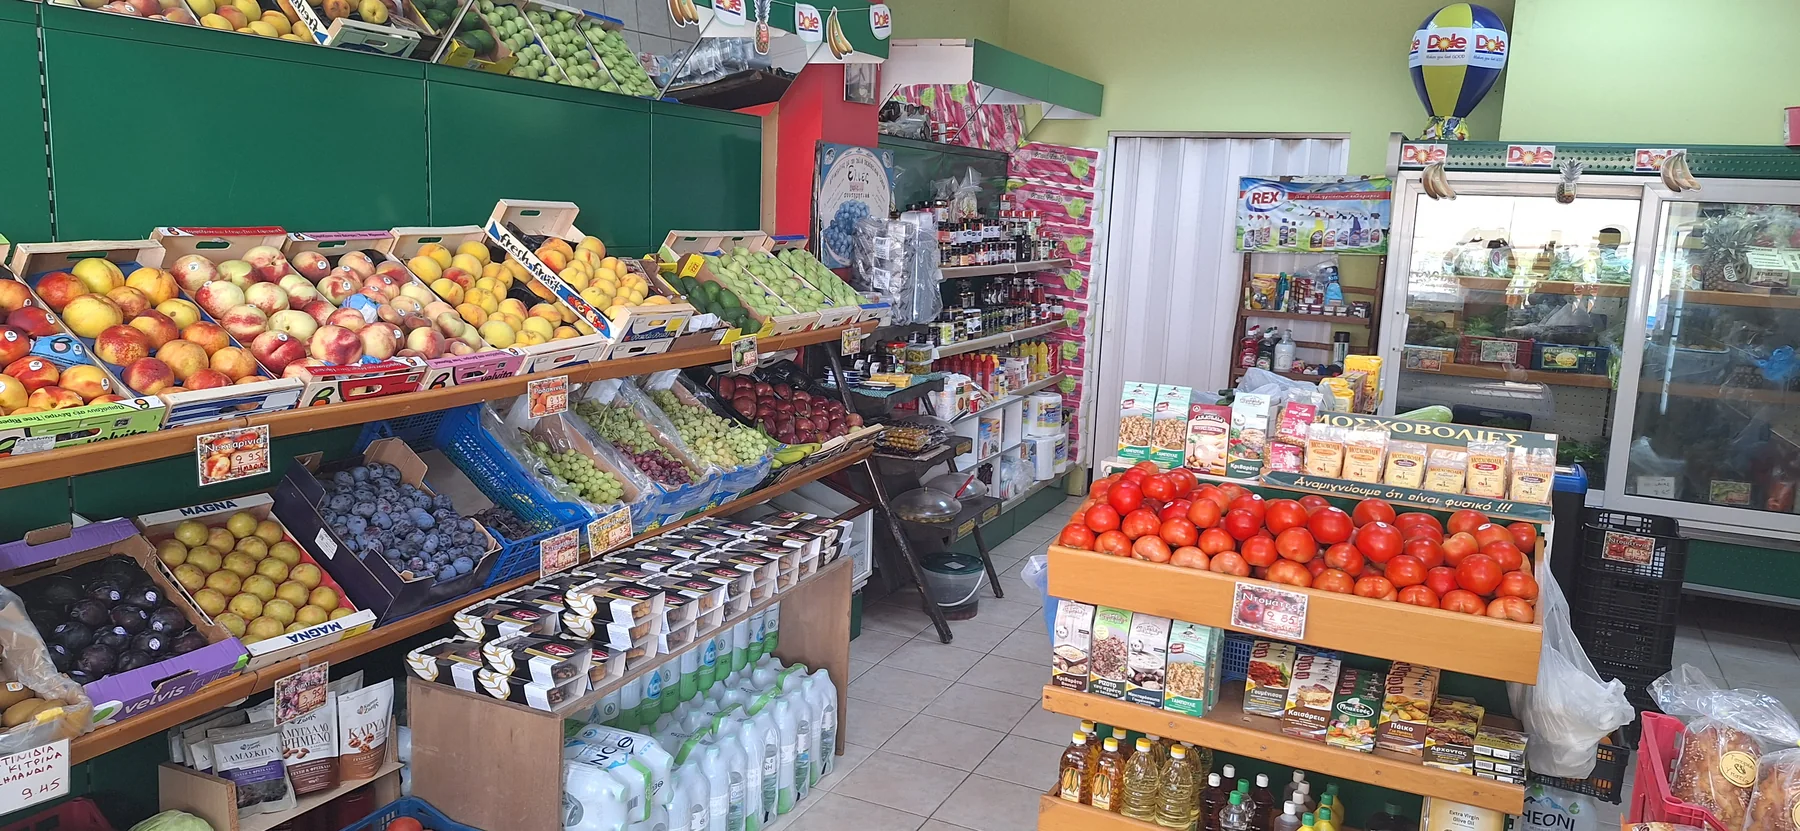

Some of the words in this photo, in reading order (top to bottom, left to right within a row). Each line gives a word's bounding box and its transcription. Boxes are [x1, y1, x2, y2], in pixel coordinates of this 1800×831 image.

[798, 11, 819, 30] Dole
[873, 9, 889, 27] Dole
[1427, 33, 1467, 51] Dole
[1476, 34, 1505, 52] Dole
[1403, 145, 1445, 163] Dole
[1508, 146, 1553, 164] Dole
[1251, 191, 1280, 204] REX
[500, 234, 529, 265] fresh
[533, 263, 561, 292] fruit
[1294, 476, 1381, 498] Αναμιγνύουμε
[1387, 488, 1406, 501] ότι
[1408, 493, 1440, 504] είναι
[1445, 498, 1491, 511] φυσικό
[179, 500, 238, 516] MAGNA
[1243, 592, 1298, 613] Ντομάτες
[1280, 614, 1297, 625] 85
[286, 622, 343, 643] MAGNA
[124, 684, 186, 714] velvis
[1288, 709, 1326, 723] Καισάρεια
[1390, 722, 1414, 732] Πάικο
[0, 745, 54, 767] ΤΙΝΙΔΙΑ
[222, 746, 280, 763] ΔΑΜΑΣΚΗΝΑ
[1449, 810, 1463, 818] Extra
[1464, 813, 1480, 821] Virgin
[1452, 816, 1467, 825] Olive
[1522, 810, 1575, 831] HEONI
